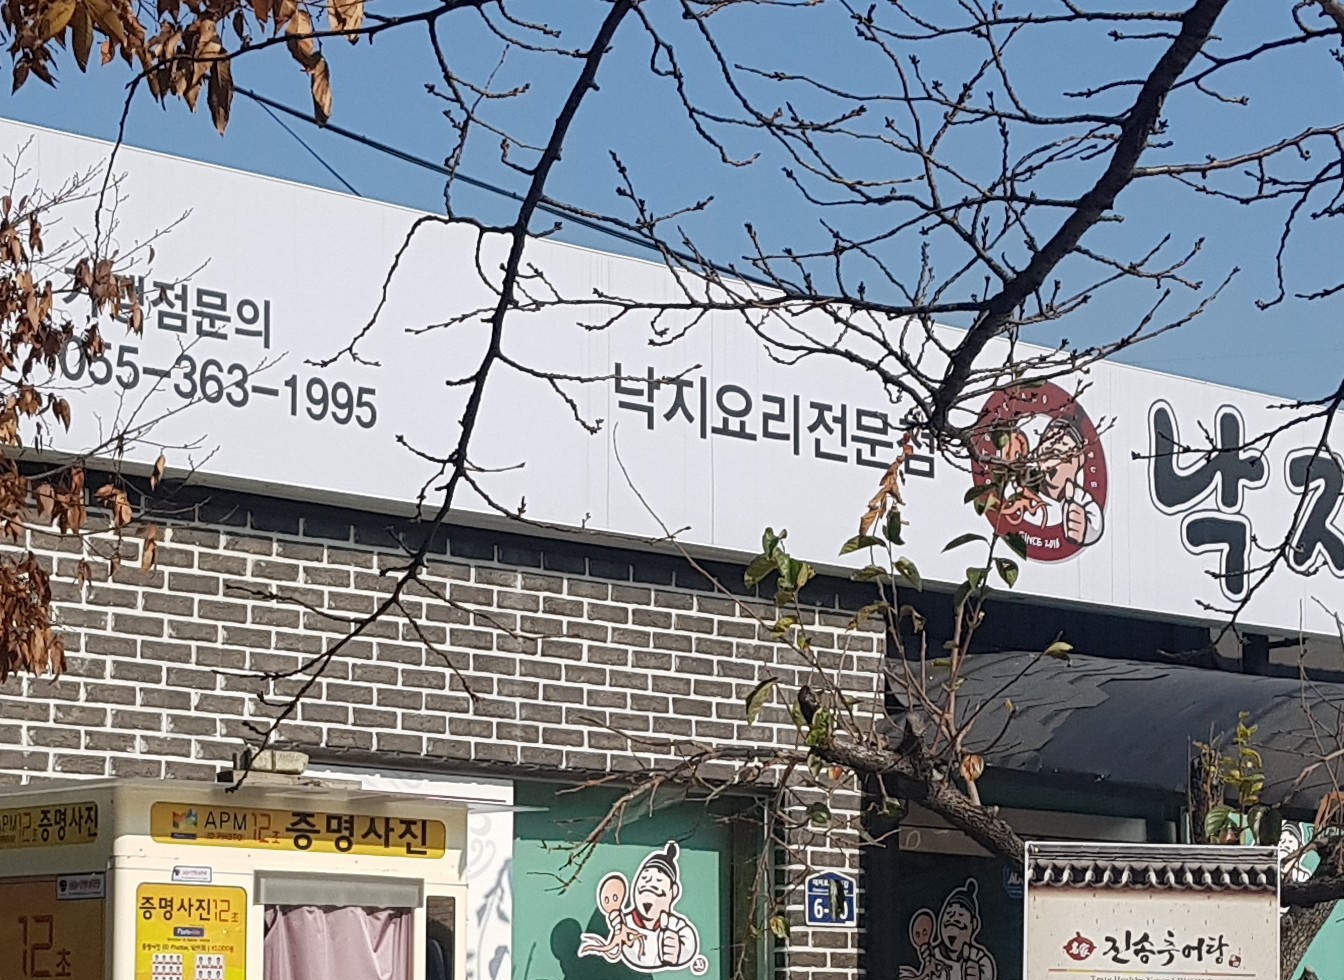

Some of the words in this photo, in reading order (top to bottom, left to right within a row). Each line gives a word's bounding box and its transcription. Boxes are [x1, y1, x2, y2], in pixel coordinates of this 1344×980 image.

[62, 335, 377, 428] 055-363-1995
[38, 806, 98, 842] 증명사진
[204, 811, 247, 831] APM
[285, 811, 428, 855] 증명사진
